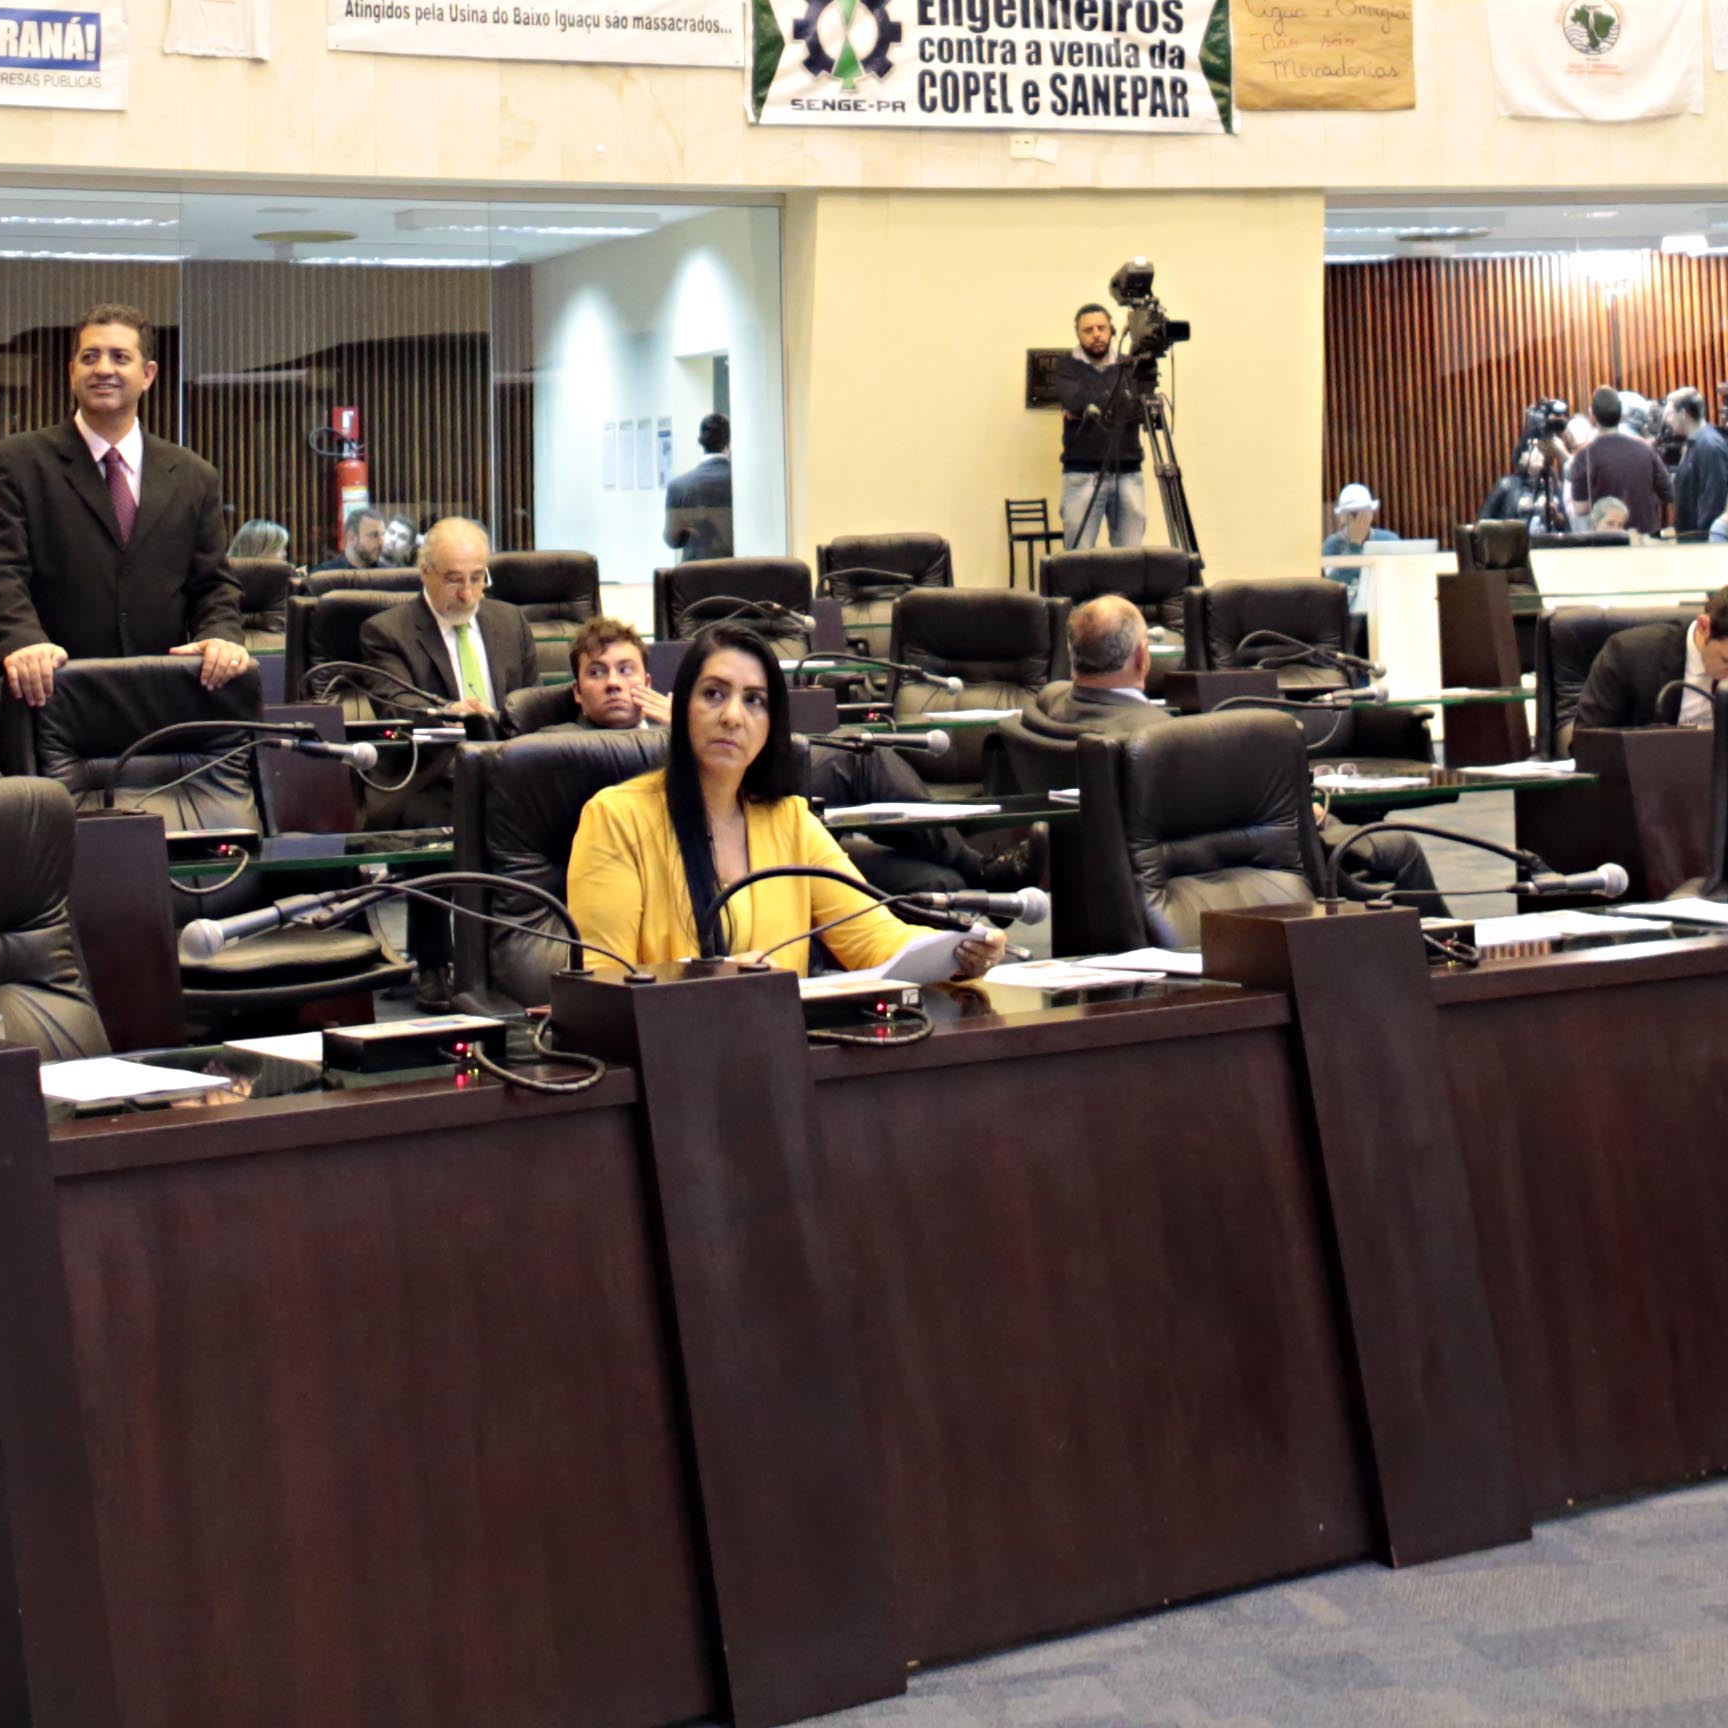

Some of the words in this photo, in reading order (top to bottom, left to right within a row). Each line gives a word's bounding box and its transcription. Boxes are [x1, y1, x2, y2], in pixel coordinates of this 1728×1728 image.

[415, 3, 444, 25] pela
[449, 3, 488, 24] Usina
[492, 6, 508, 25] do
[513, 6, 550, 27] Baixo
[555, 9, 600, 34] Iguaçu
[605, 10, 628, 30] são
[632, 14, 732, 35] massacrados...
[918, 36, 1017, 67] contra
[1024, 43, 1042, 67] a
[1050, 38, 1140, 69] venda
[1148, 39, 1185, 70] da
[43, 72, 102, 89] PÚBLICAS
[1259, 55, 1399, 81] Mercadorias
[790, 99, 906, 113] SENGE-PR
[917, 70, 1014, 114] COPEL
[1024, 81, 1040, 115] e
[1049, 72, 1190, 118] SANEPAR
